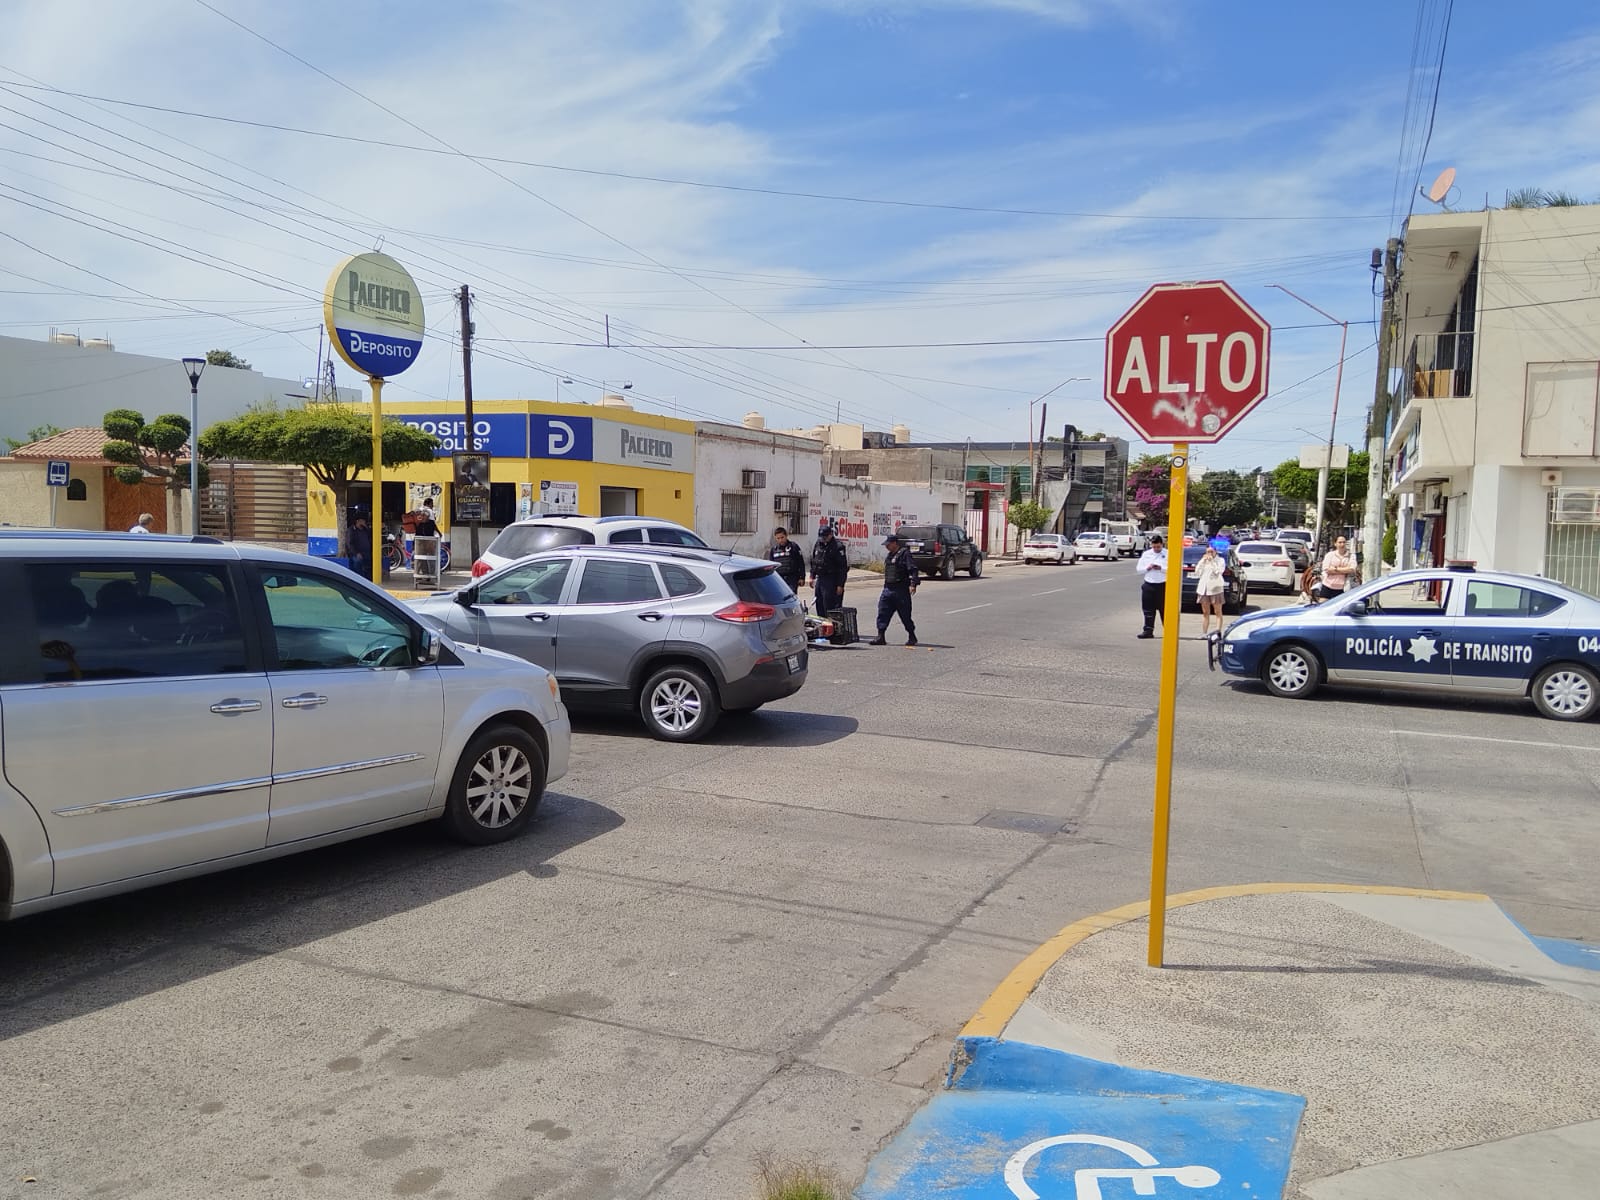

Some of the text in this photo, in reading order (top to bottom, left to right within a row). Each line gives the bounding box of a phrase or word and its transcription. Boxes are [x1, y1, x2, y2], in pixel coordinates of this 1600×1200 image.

[349, 271, 410, 315] PACIFICO
[350, 333, 412, 358] DEPOSITO
[1116, 331, 1257, 394] ALTO
[400, 421, 491, 436] POSITO
[621, 428, 672, 459] PACIFICO
[1346, 635, 1532, 664] POLICÍA DE TRANSITO
[1578, 636, 1600, 653] 04
